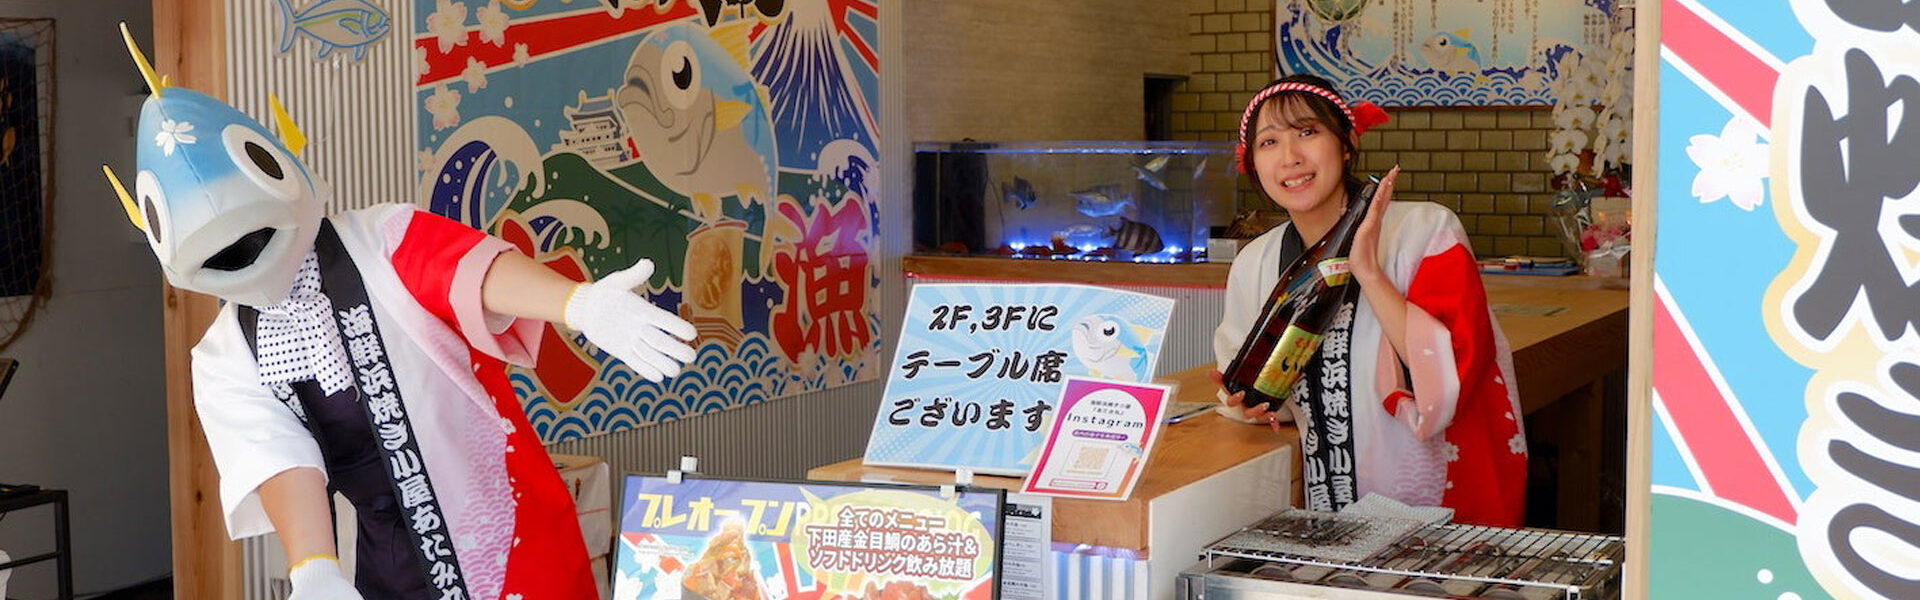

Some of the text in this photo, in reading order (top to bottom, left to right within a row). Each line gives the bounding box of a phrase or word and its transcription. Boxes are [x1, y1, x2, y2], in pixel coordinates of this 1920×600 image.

[774, 197, 870, 363] 漁
[928, 305, 1058, 334] 2F,3Fに
[901, 349, 1067, 383] テーブル席
[888, 397, 1052, 432] ございます
[1067, 412, 1144, 429] Instagram
[638, 493, 796, 536] プレオープン
[838, 505, 946, 532] 全てのメニュー
[809, 549, 974, 581] ソフトドリンク飲み放題
